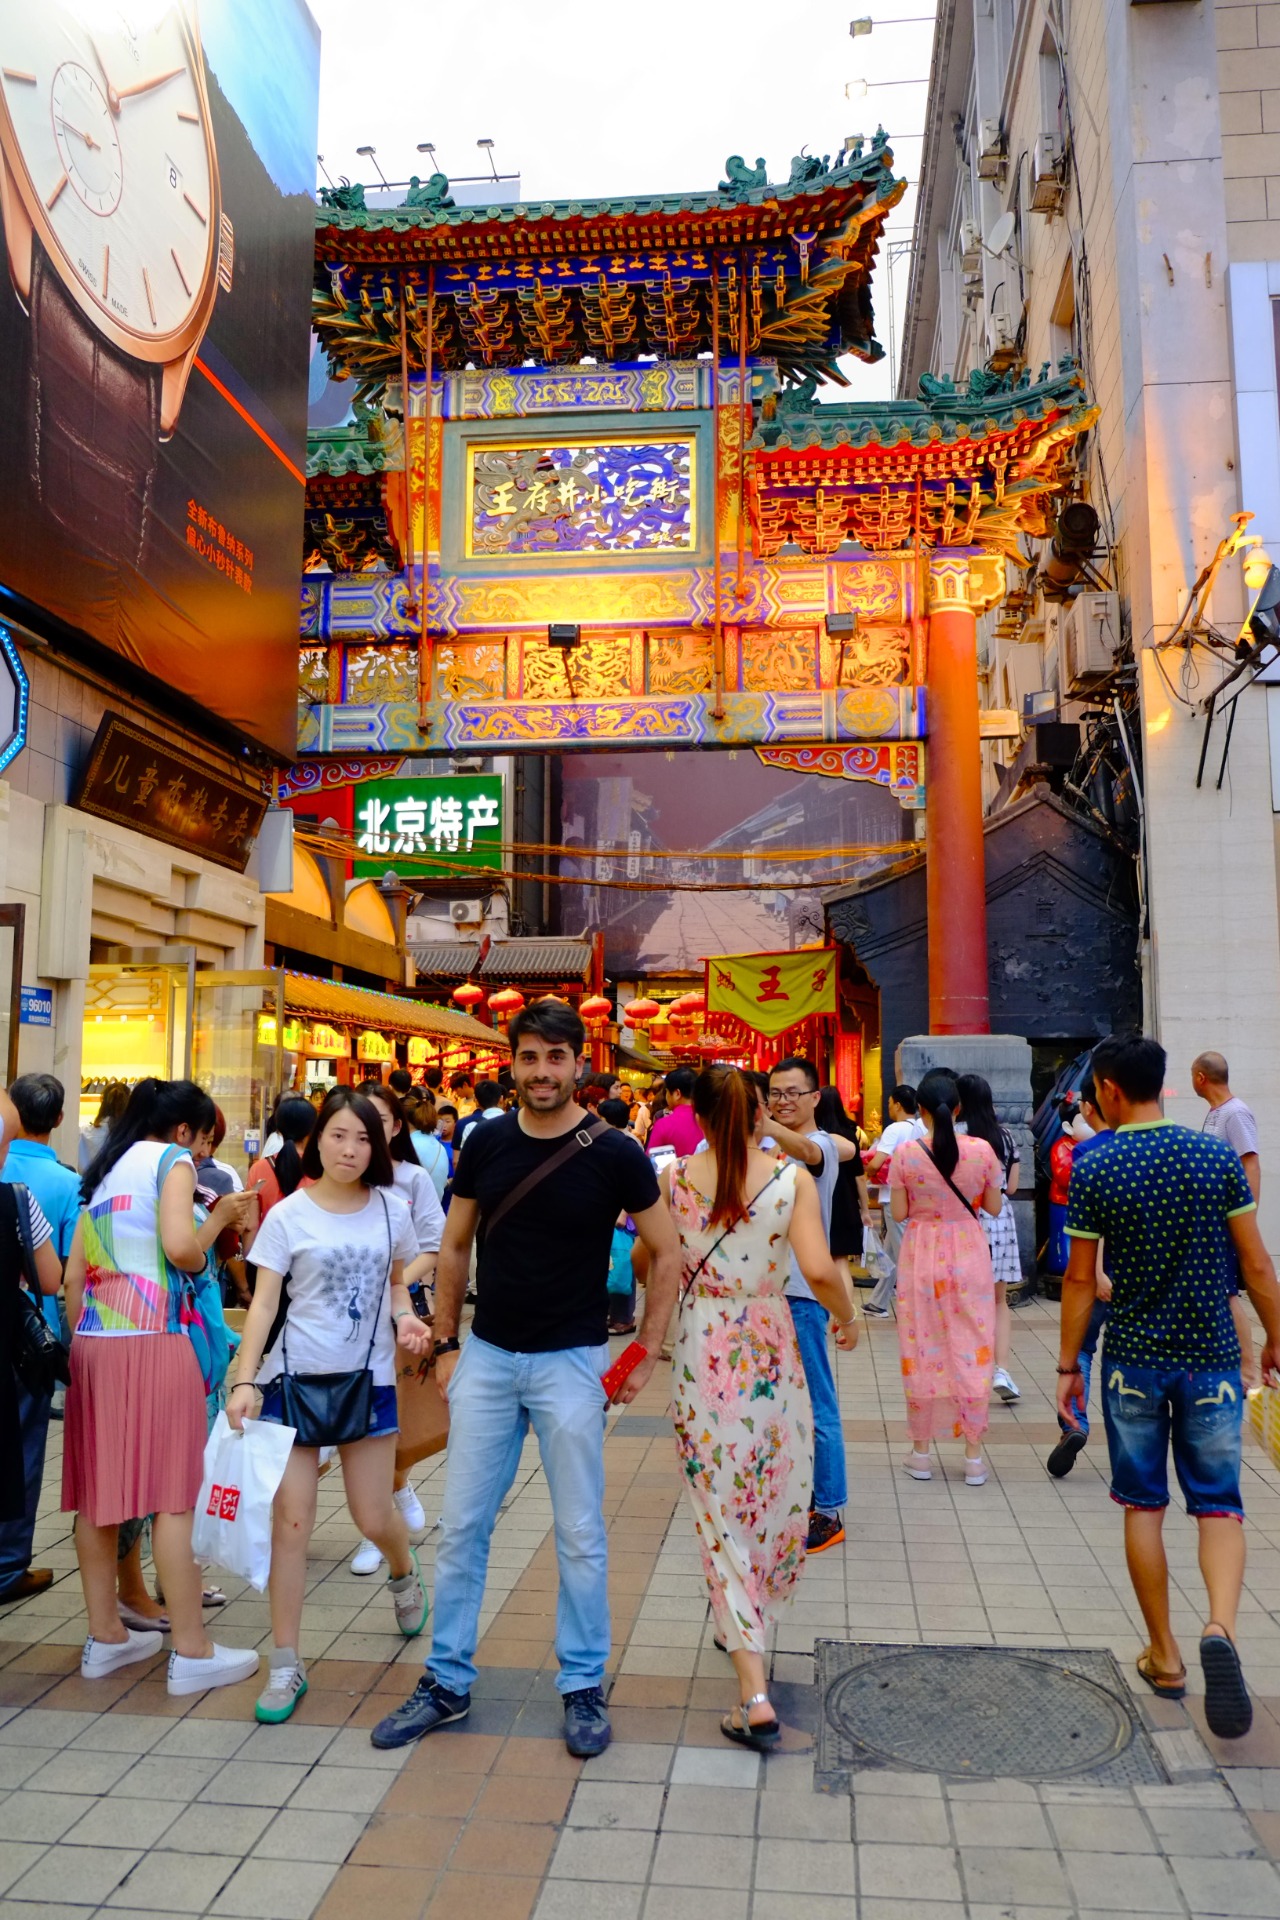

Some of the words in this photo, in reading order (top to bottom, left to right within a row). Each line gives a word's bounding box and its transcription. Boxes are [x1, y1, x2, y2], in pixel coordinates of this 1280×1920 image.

[77, 258, 98, 287] SWISS
[111, 297, 129, 317] MADE
[486, 477, 680, 516] 王府井小吃街
[186, 524, 252, 595] 偏心小秒针表款
[187, 498, 254, 571] 全新布鲁纳系列
[357, 794, 499, 854] 北京特产
[28, 998, 51, 1013] 96010
